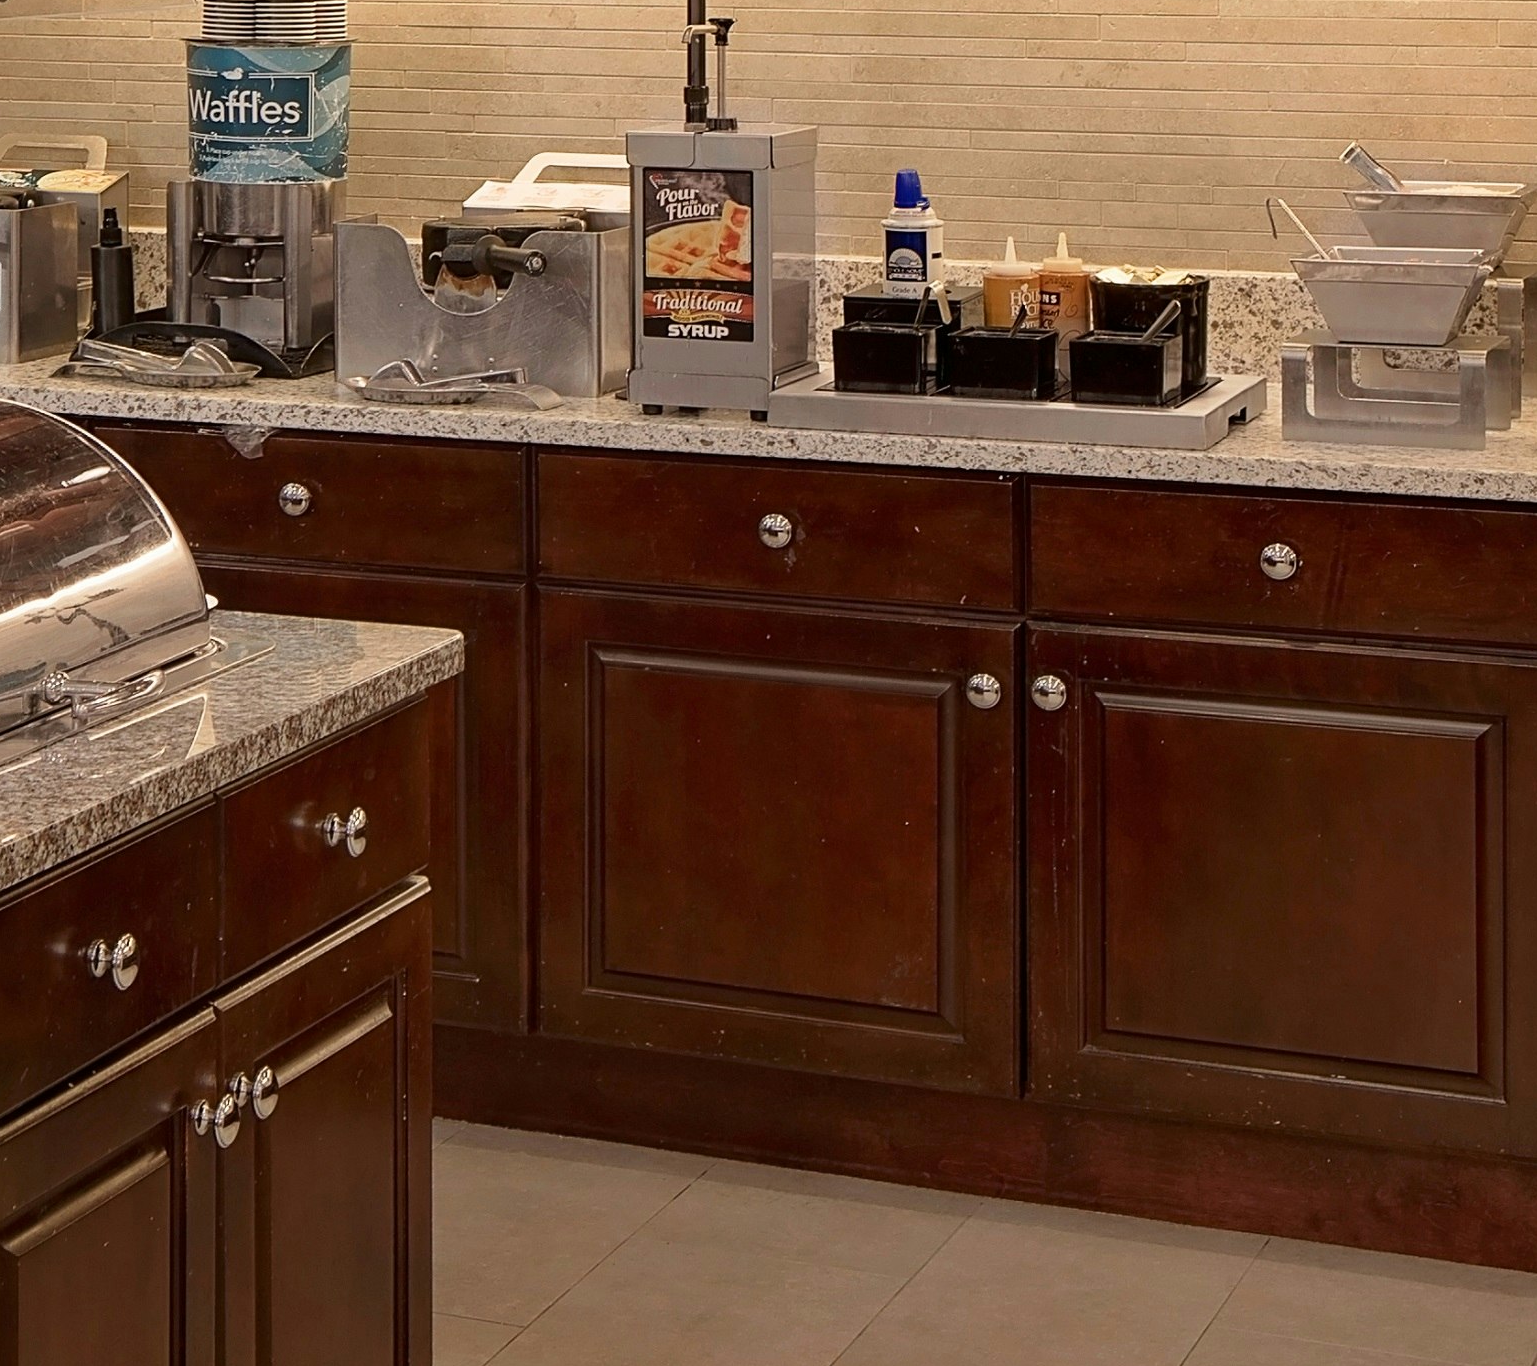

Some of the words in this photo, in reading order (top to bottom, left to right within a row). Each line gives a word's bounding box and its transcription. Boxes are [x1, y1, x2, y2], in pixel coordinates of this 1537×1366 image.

[189, 88, 302, 124] Waffles
[656, 188, 700, 207] Pour
[665, 202, 719, 221] Flavor
[652, 294, 743, 314] Traditional
[1010, 288, 1040, 305] HOU
[667, 324, 729, 339] SYRUP
